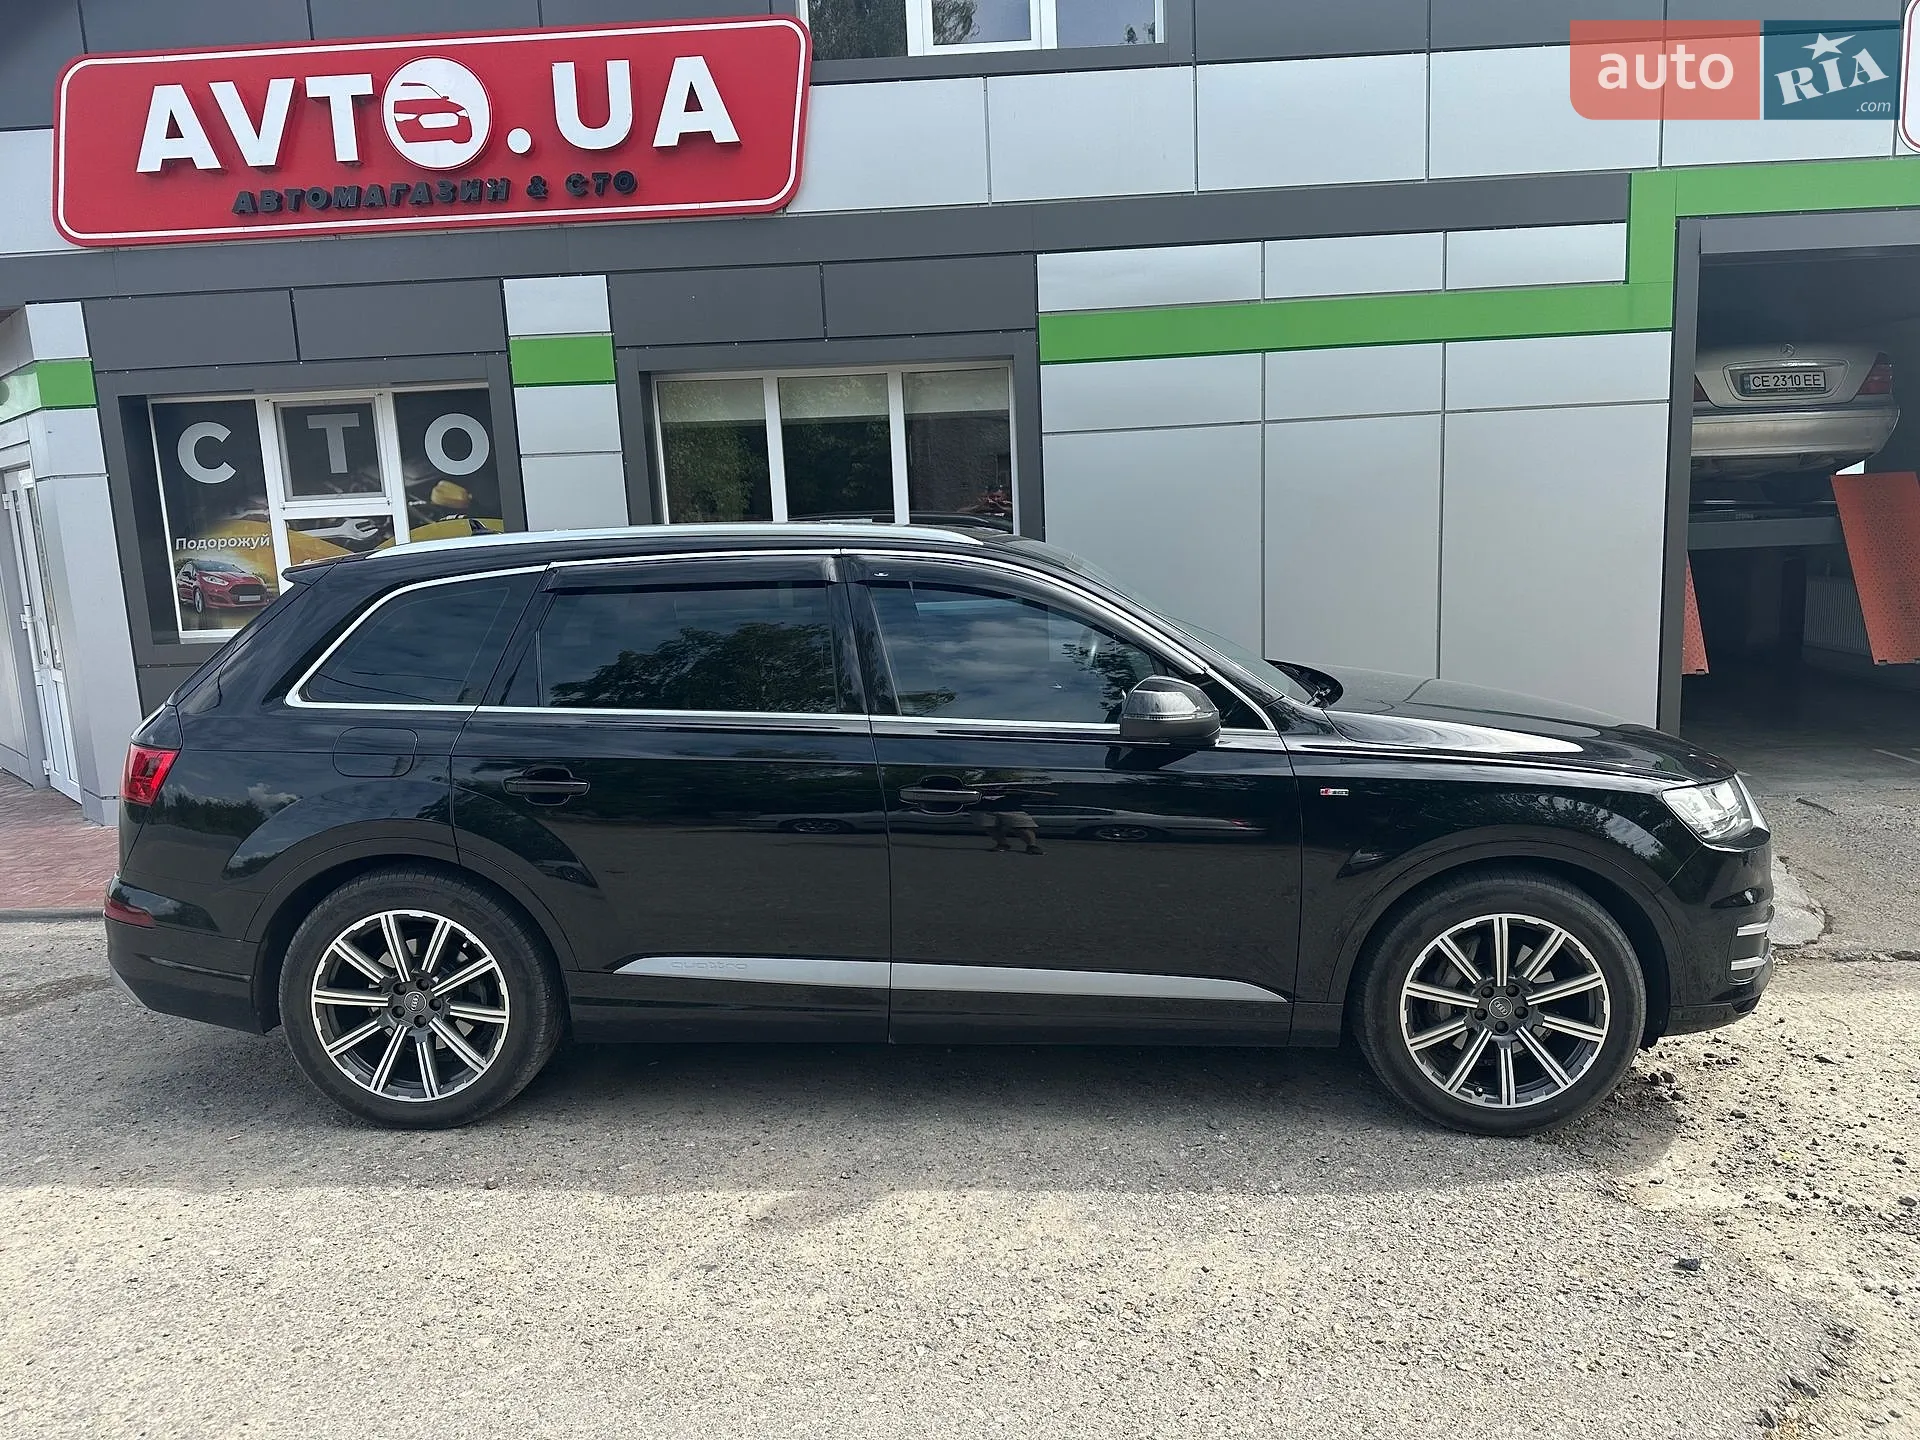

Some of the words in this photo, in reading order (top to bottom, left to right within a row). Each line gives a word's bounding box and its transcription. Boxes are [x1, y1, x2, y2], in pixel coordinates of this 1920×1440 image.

[232, 177, 510, 215] АВТОМАГАЗИН
[525, 175, 549, 199] &
[565, 170, 638, 196] СТО
[1752, 375, 1770, 388] CE
[1772, 374, 1801, 387] 2310
[1803, 374, 1822, 386] EE
[174, 533, 271, 551] Подорожуй
[670, 960, 748, 971] quattro
